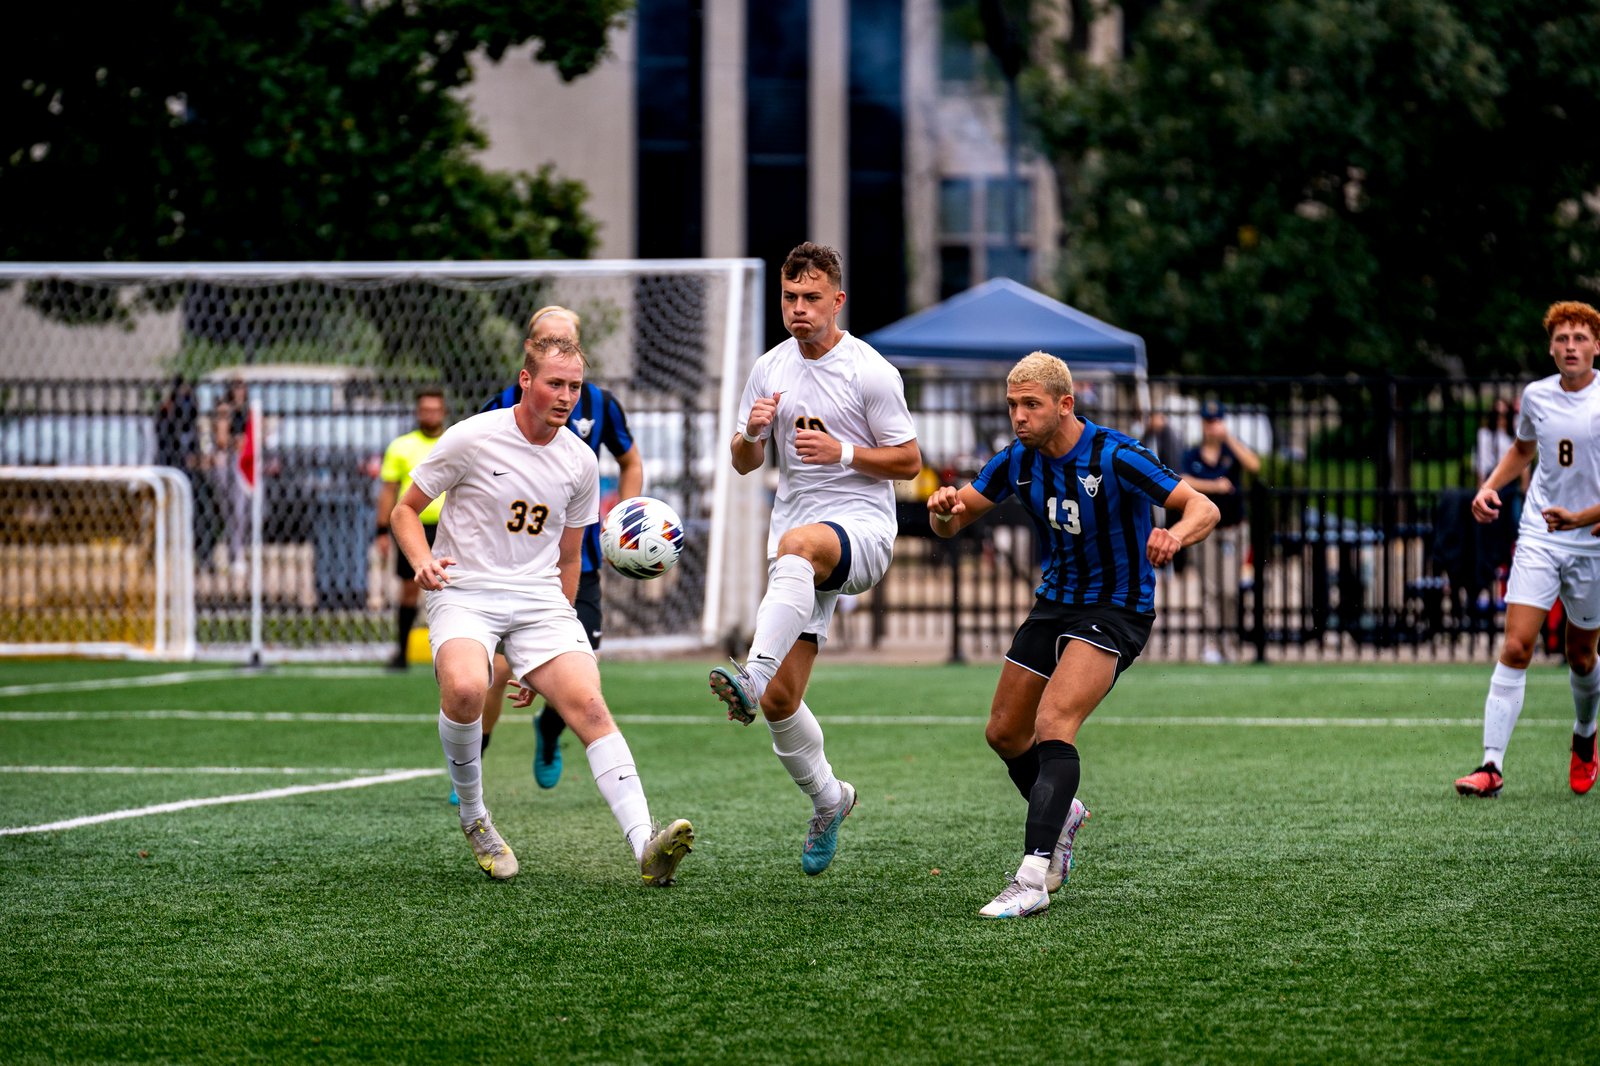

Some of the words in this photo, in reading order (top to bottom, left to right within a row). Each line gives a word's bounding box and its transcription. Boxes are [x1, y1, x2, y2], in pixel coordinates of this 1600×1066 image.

[1558, 438, 1574, 468] 8
[506, 499, 550, 537] 33
[1047, 496, 1082, 535] 13
